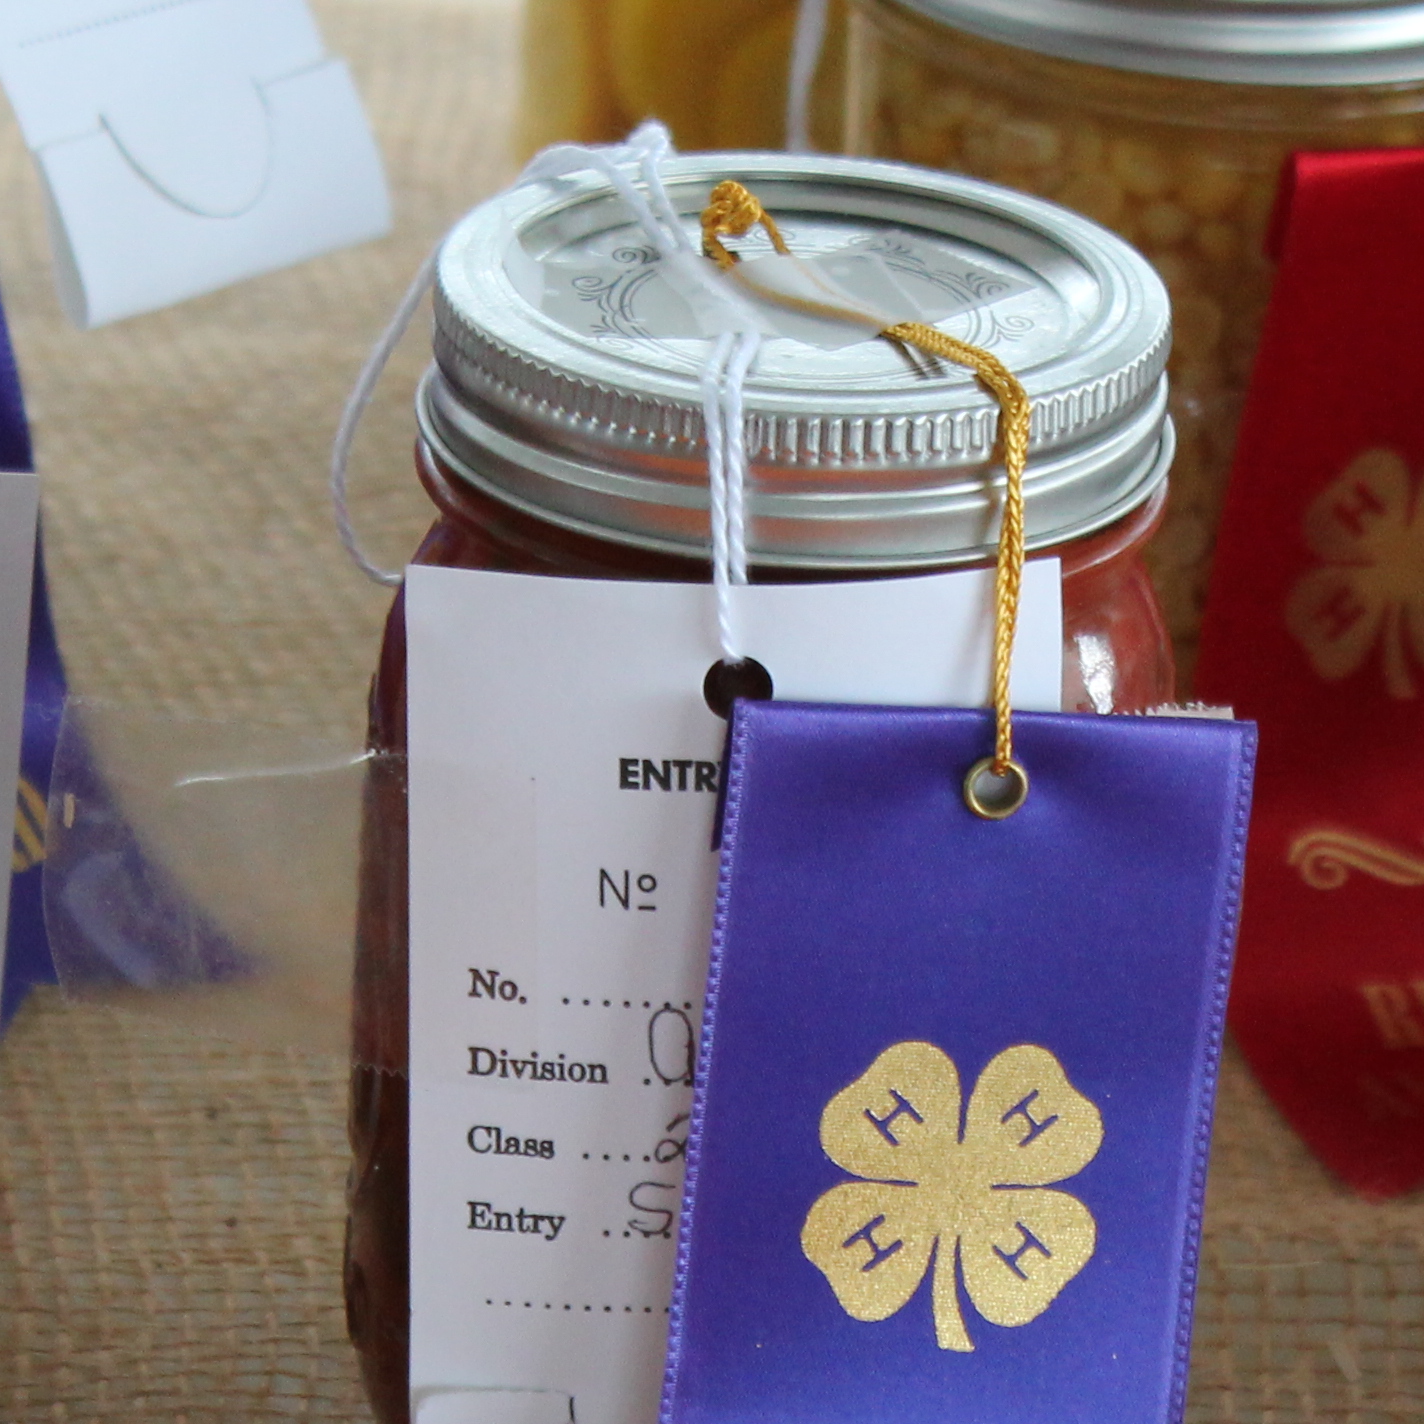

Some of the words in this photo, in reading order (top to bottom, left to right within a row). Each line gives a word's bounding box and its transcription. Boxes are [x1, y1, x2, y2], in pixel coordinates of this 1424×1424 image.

[619, 757, 725, 792] ENTR
[467, 968, 528, 1004] No.
[467, 1047, 609, 1085] Division
[467, 1125, 556, 1160] Class
[467, 1201, 566, 1241] Entry
